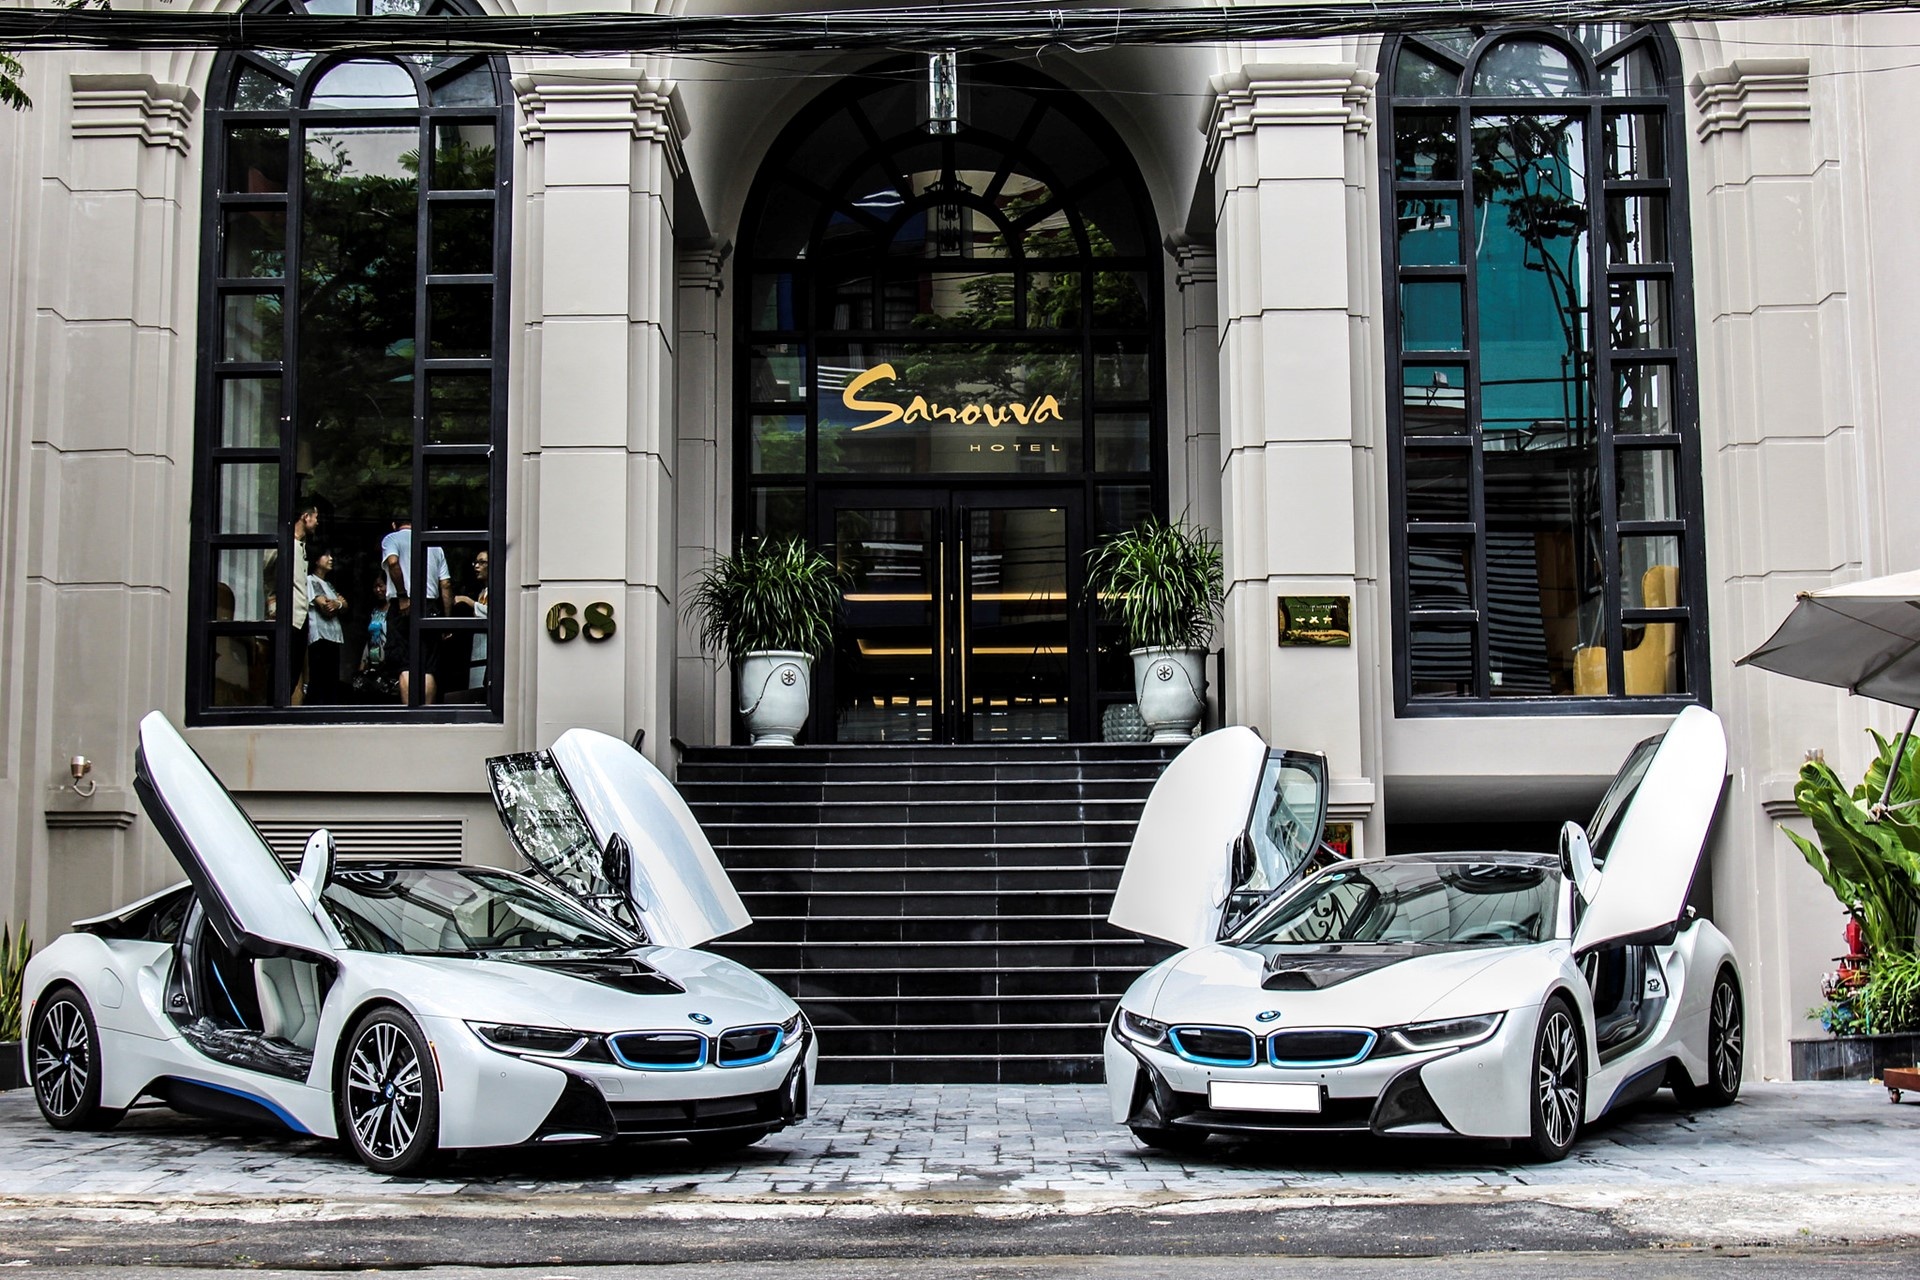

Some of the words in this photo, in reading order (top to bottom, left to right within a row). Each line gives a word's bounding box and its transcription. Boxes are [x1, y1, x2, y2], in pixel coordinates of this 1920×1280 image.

[842, 363, 1063, 431] Sanouva
[970, 444, 1060, 452] HOTEL
[546, 602, 617, 644] 68
